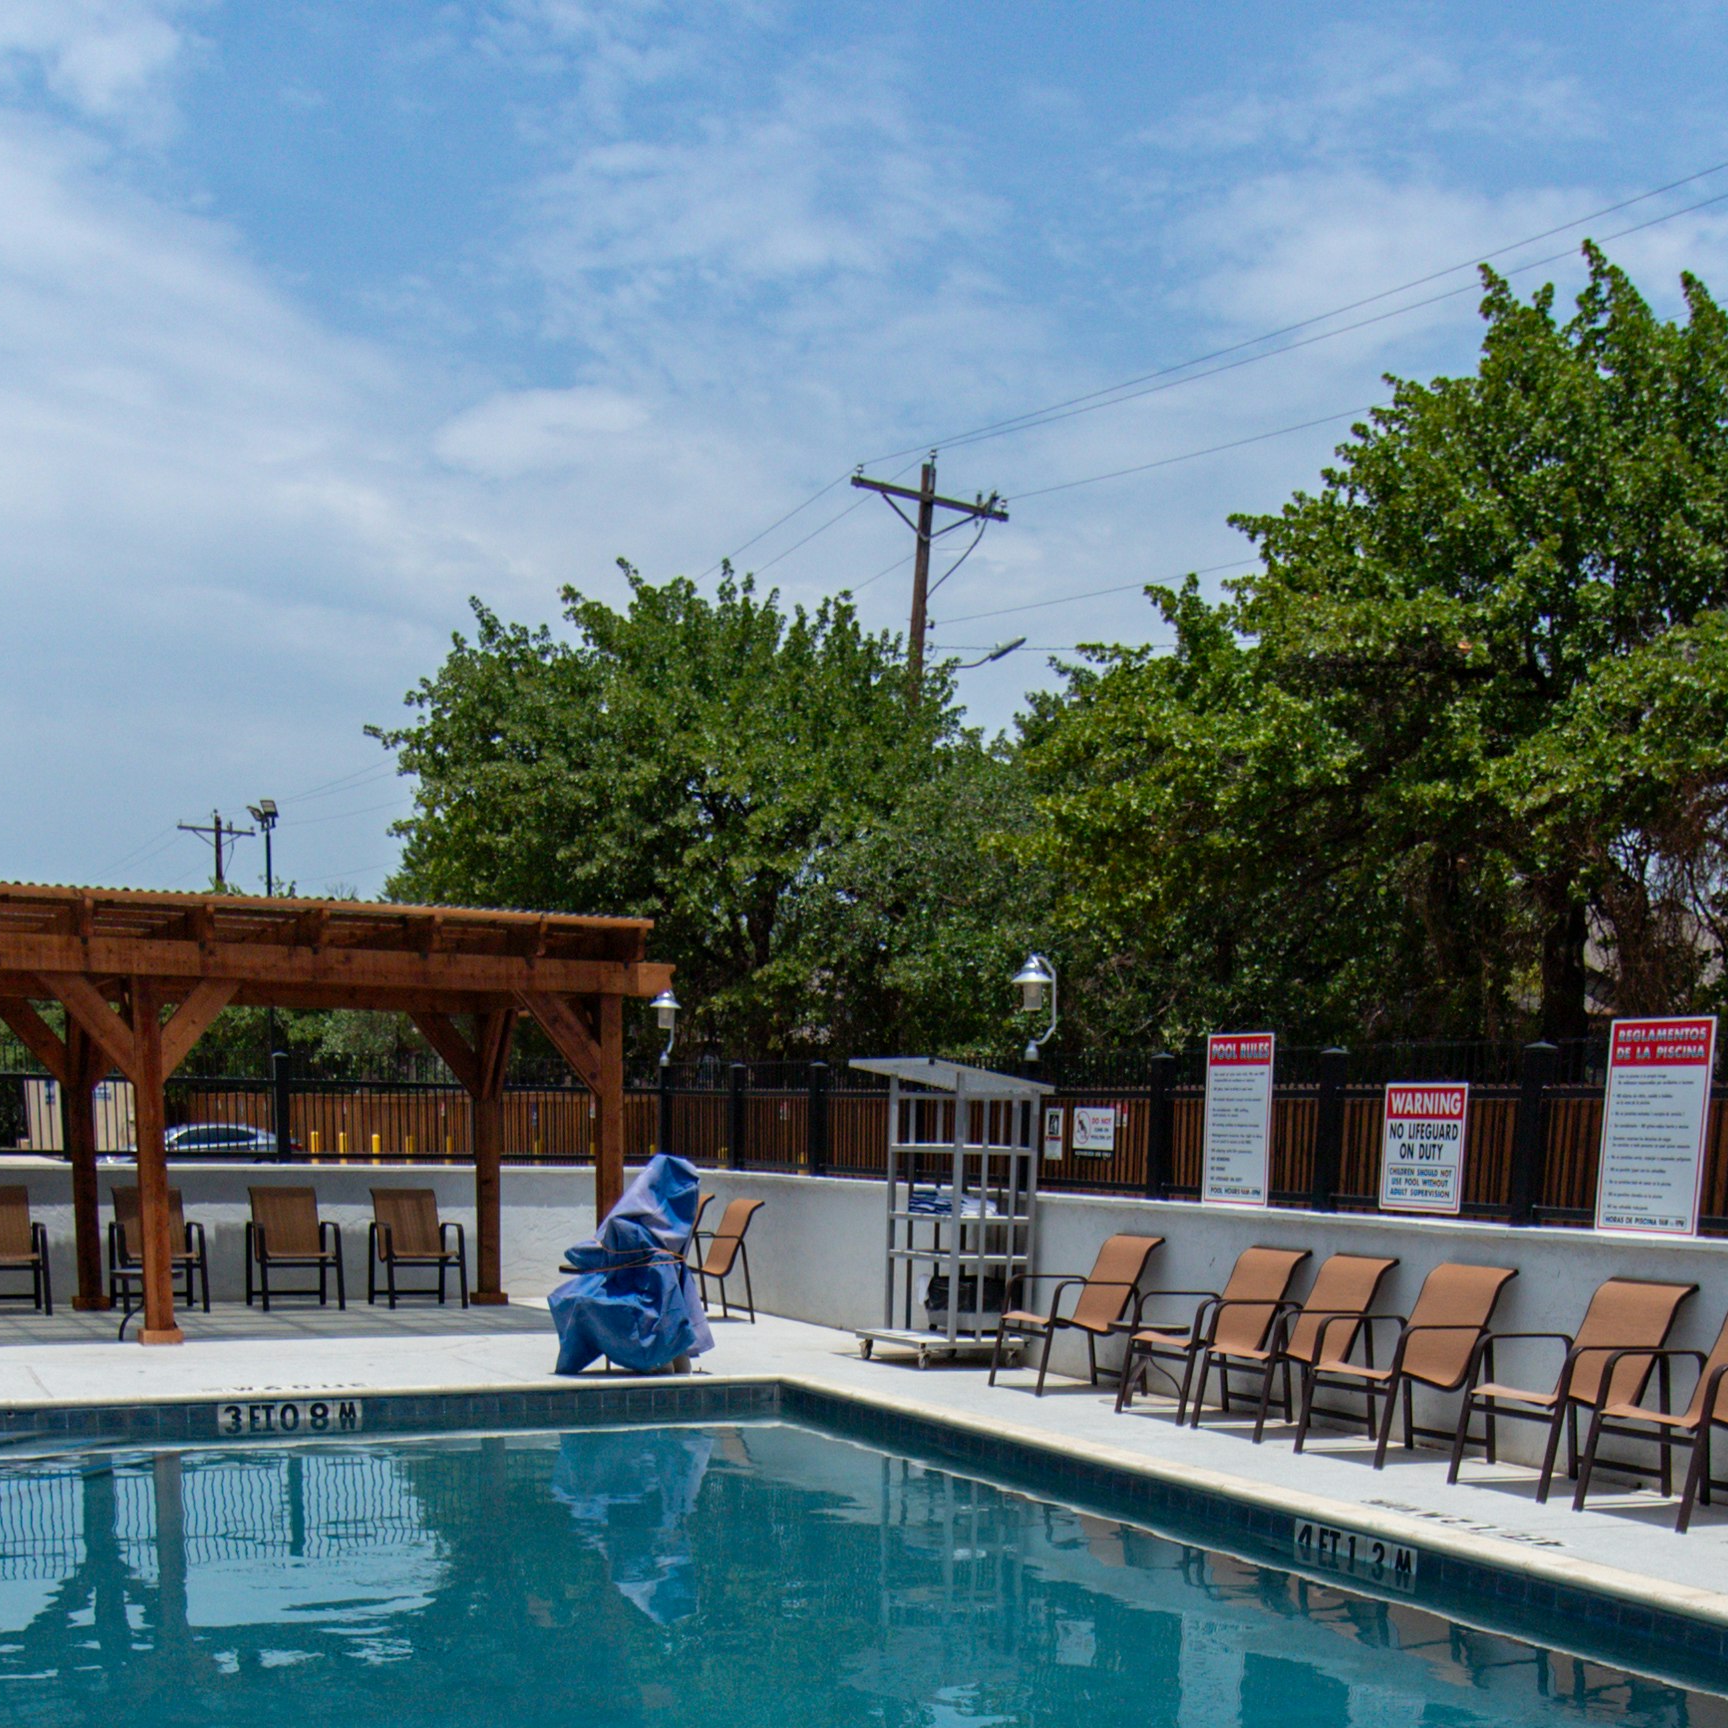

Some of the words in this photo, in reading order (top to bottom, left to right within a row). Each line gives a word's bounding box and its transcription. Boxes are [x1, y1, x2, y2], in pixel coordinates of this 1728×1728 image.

[1618, 1027, 1707, 1042] REGLAMENTOS
[1211, 1043, 1237, 1060] POOL
[1240, 1042, 1270, 1059] RULES
[1616, 1046, 1632, 1059] DE
[1636, 1046, 1651, 1059] LA
[1656, 1045, 1706, 1059] PISCINA
[1391, 1092, 1462, 1115] WARNING
[1389, 1123, 1404, 1139] NO
[1408, 1123, 1459, 1141] LIFEGUARD
[1399, 1143, 1414, 1160] ON
[1418, 1143, 1444, 1160] DUTY
[1389, 1167, 1415, 1176] CHILDREN
[1417, 1168, 1438, 1177] SHOULD
[1440, 1169, 1452, 1178] NOT
[1391, 1178, 1402, 1186] USE
[1404, 1178, 1419, 1186] POOL
[1422, 1179, 1449, 1187] WITHOUT
[1389, 1188, 1408, 1196] ADULT
[1410, 1189, 1450, 1198] SUPERVISION
[1634, 1218, 1657, 1226] PISCINA
